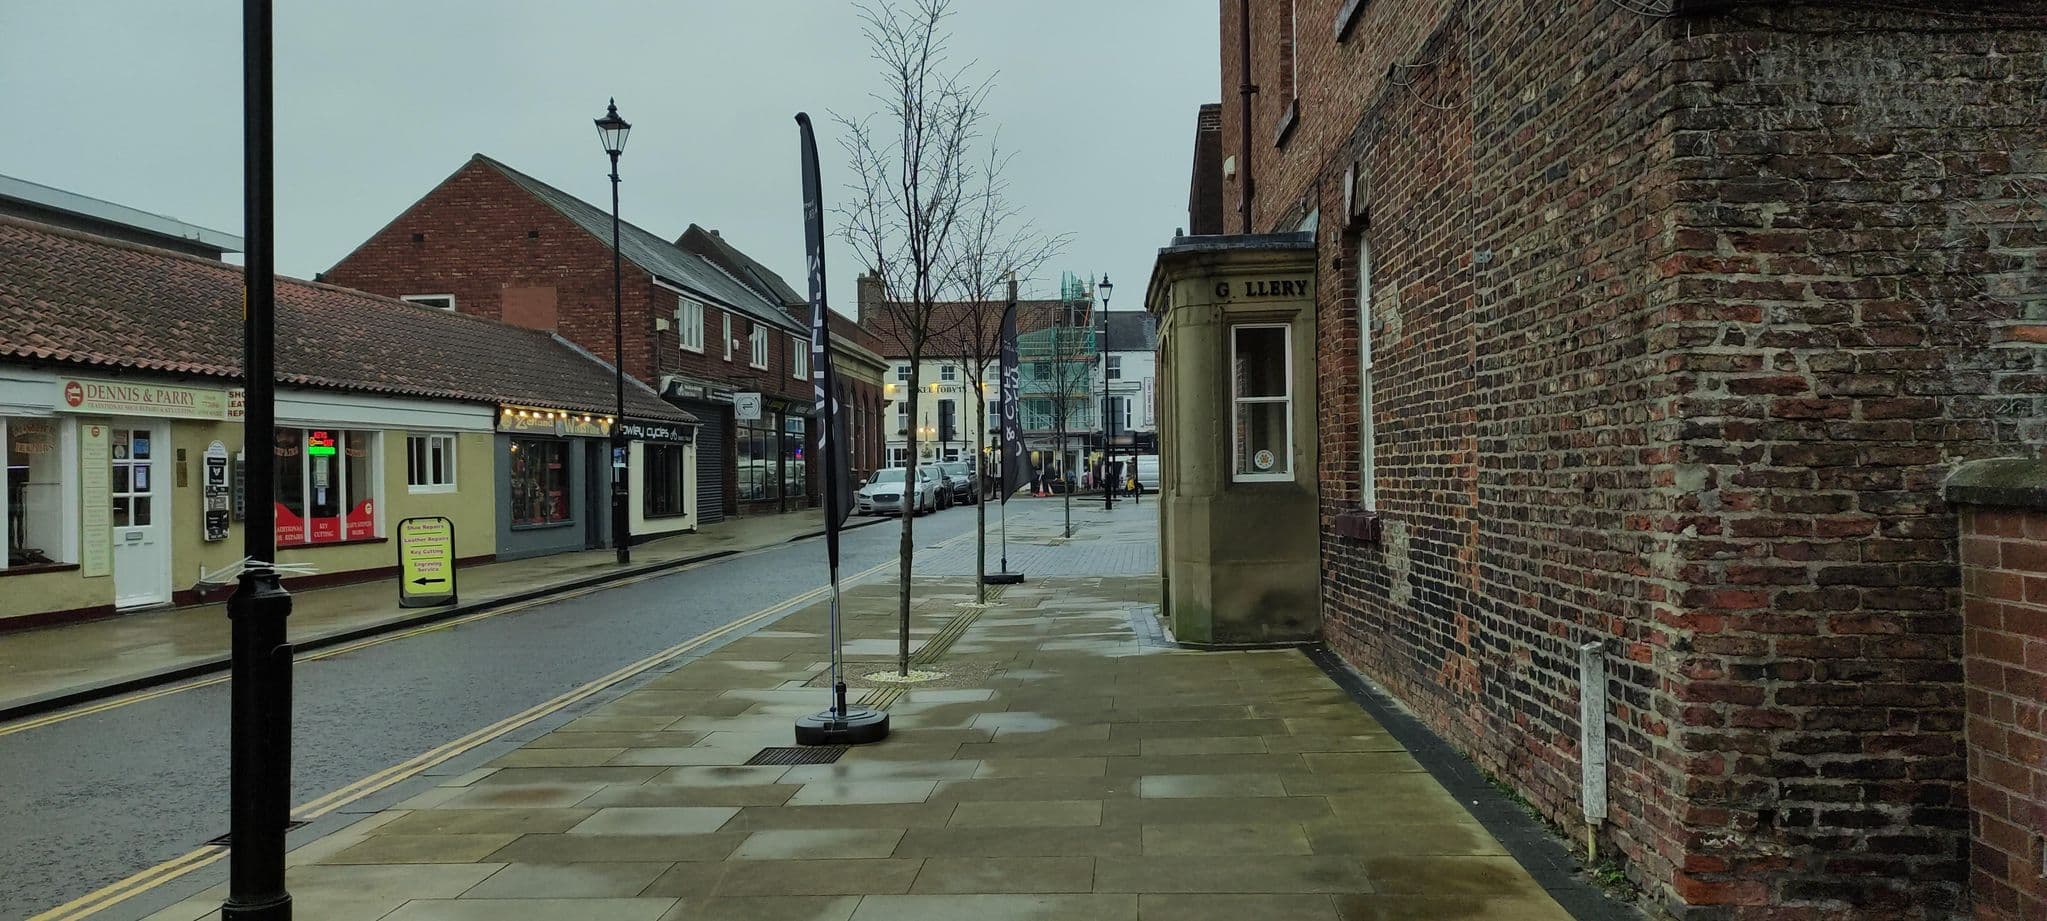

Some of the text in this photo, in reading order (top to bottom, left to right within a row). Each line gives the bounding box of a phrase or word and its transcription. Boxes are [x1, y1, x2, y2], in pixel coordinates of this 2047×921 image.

[86, 384, 140, 401] DENNIS
[143, 388, 152, 402] &
[156, 389, 196, 406] PARRY
[623, 424, 644, 438] owley
[646, 425, 669, 438] cycles
